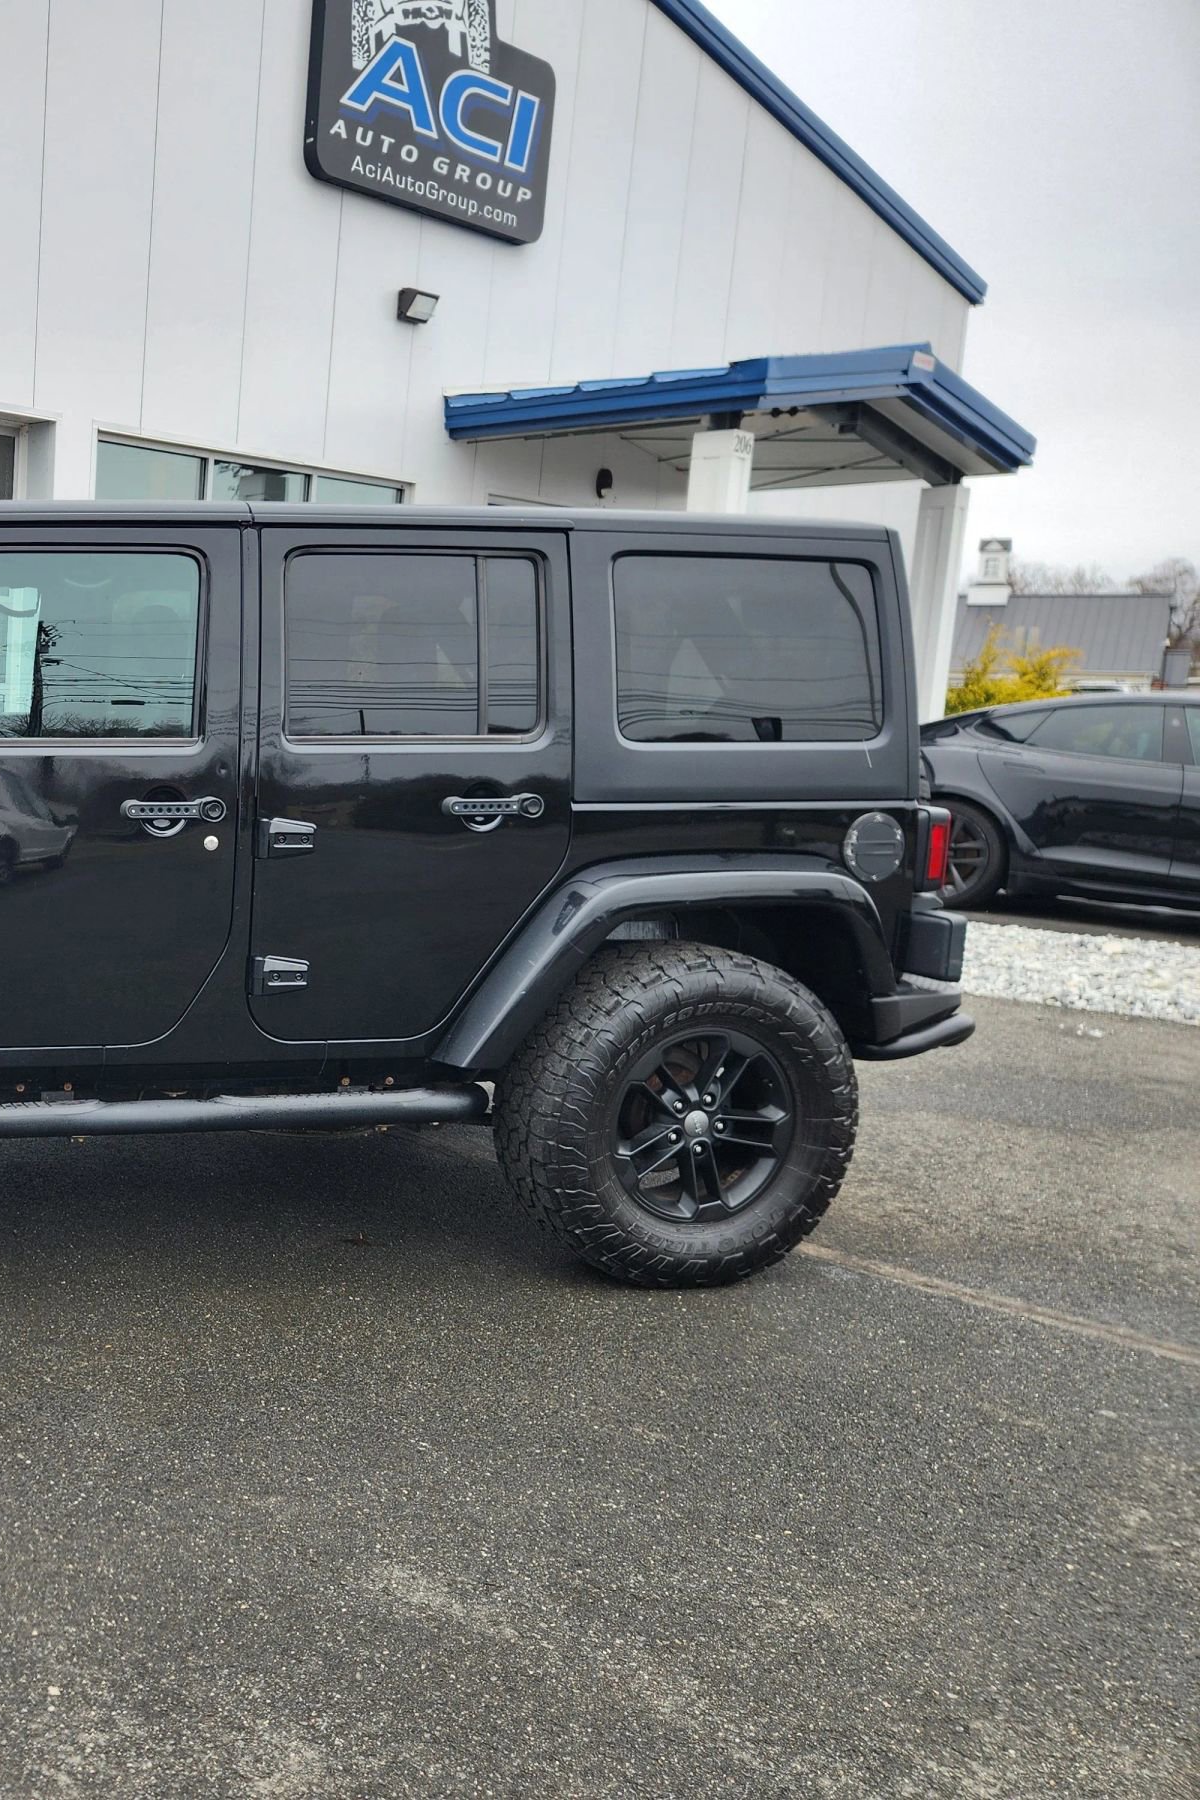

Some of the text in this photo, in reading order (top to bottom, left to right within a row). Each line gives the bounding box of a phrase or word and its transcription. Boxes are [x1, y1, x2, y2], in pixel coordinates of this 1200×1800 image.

[339, 34, 541, 173] ACI
[329, 118, 533, 203] AUTO GROUP
[350, 155, 518, 228] AciAutoGroup.com
